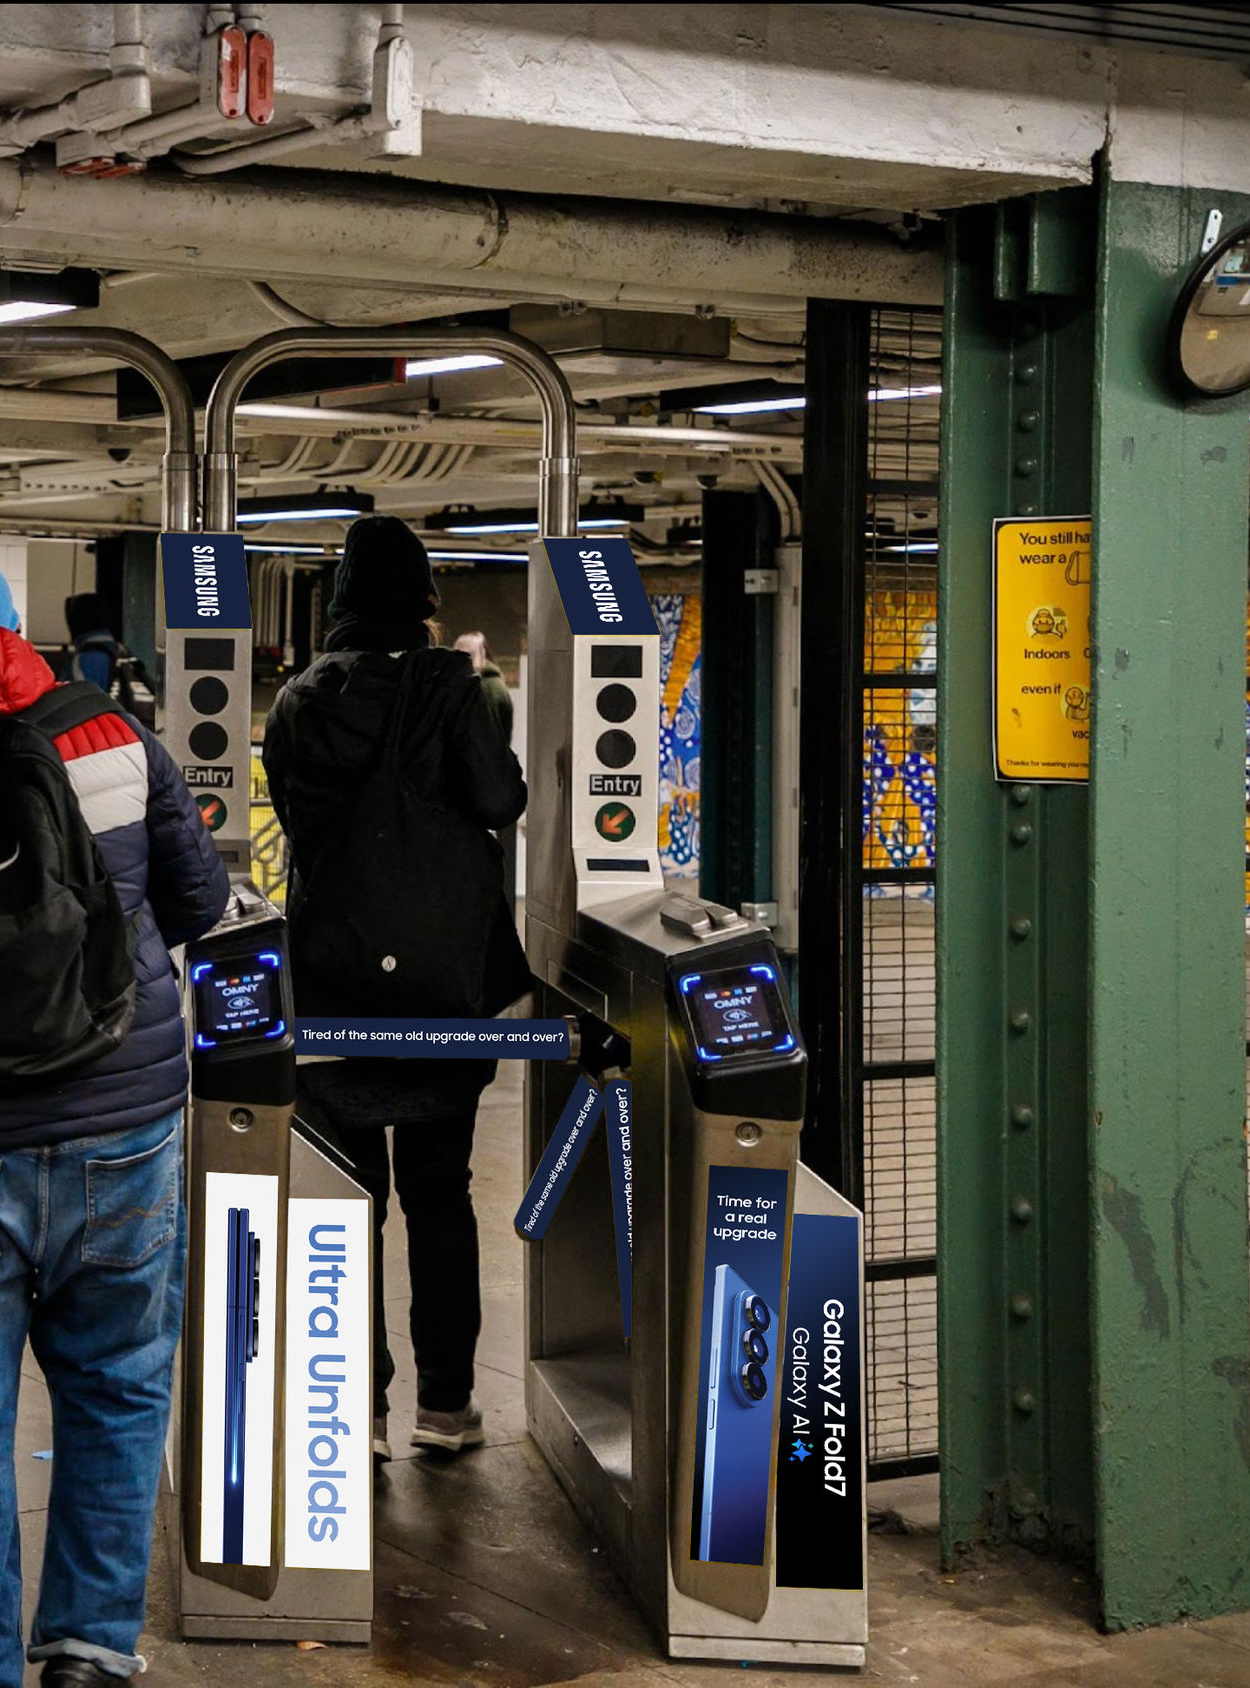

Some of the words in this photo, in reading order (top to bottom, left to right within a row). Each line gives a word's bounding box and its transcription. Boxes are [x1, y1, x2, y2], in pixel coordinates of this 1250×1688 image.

[1019, 533, 1047, 545] You
[1050, 531, 1072, 544] still
[1075, 531, 1091, 543] ha
[1019, 553, 1055, 564] wear
[1058, 553, 1066, 563] a
[192, 545, 220, 617] SAMSUNG
[578, 550, 623, 623] SAMSUNG
[1024, 648, 1070, 659] Indoors
[1021, 685, 1052, 694] even
[1054, 683, 1062, 694] if
[184, 767, 232, 787] Entry
[590, 776, 641, 795] Entry
[221, 983, 259, 997] OMNY
[714, 995, 753, 1009] OMNY
[738, 1021, 759, 1029] HERE
[302, 1029, 331, 1040] Tired
[334, 1029, 346, 1040] of
[348, 1030, 368, 1040] the
[370, 1032, 403, 1041] same
[405, 1030, 423, 1041] old
[425, 1031, 476, 1044] upgrade
[478, 1033, 504, 1042] over
[506, 1031, 530, 1042] and
[532, 1032, 564, 1043] over?
[583, 1088, 598, 1112] over?
[615, 1087, 629, 1124] over?
[575, 1109, 588, 1127] and
[568, 1126, 580, 1144] over
[618, 1125, 631, 1151] and
[554, 1143, 572, 1172] upgrade
[549, 1169, 559, 1183] old
[622, 1154, 632, 1180] over
[540, 1182, 553, 1201] same
[534, 1200, 545, 1211] the
[716, 1194, 752, 1208] Time
[755, 1196, 778, 1209] for
[532, 1208, 540, 1218] of
[724, 1212, 735, 1222] a
[738, 1213, 767, 1224] real
[524, 1215, 537, 1232] Tired
[713, 1227, 777, 1241] upgrade
[308, 1224, 348, 1338] Ultra
[817, 1298, 845, 1398] Galaxy
[786, 1326, 810, 1409] Galaxy
[824, 1401, 846, 1417] Z
[792, 1413, 811, 1435] AI
[307, 1354, 351, 1543] Unfolds
[824, 1423, 846, 1497] Fold7
